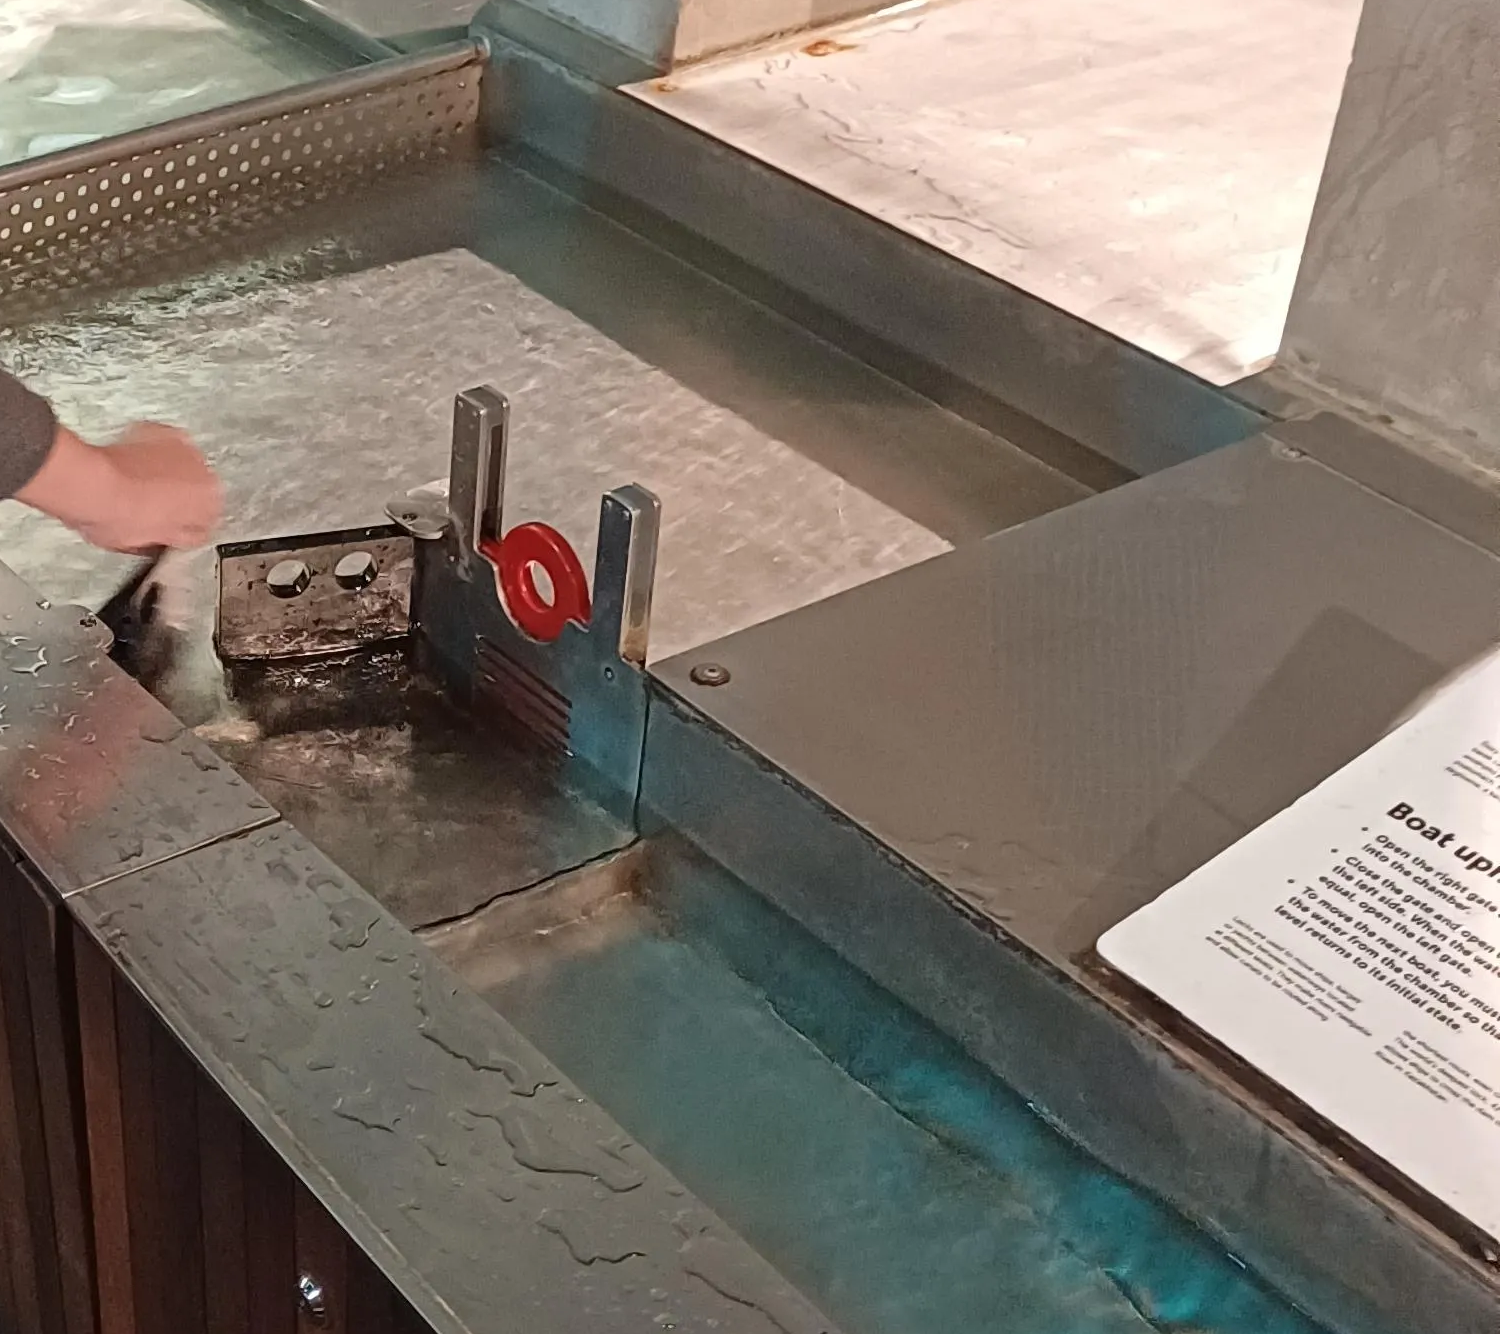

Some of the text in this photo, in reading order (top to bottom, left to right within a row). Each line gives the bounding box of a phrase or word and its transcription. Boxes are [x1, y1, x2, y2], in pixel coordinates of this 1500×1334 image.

[1375, 834, 1498, 912] Open the right gate
[1385, 801, 1455, 848] Boat
[1318, 875, 1473, 977] equal, open the left gate.
[1332, 865, 1354, 882] the
[1354, 877, 1380, 897] left
[1378, 895, 1407, 917] side.
[1411, 914, 1449, 942] When
[1449, 939, 1473, 956] the
[1345, 856, 1496, 954] Close the gate and open
[1361, 843, 1471, 915] into the chamber.
[1274, 904, 1462, 1034] level returns to its initial state.
[1287, 896, 1310, 913] the
[1310, 910, 1349, 937] water
[1347, 934, 1380, 960] from
[1380, 956, 1403, 974] the
[1403, 973, 1463, 1012] chamber
[1462, 1011, 1480, 1023] so
[1302, 886, 1319, 900] To
[1317, 897, 1353, 922] move
[1353, 920, 1376, 938] the
[1376, 934, 1409, 959] next
[1406, 955, 1440, 981] boat,
[1439, 979, 1470, 999] you
